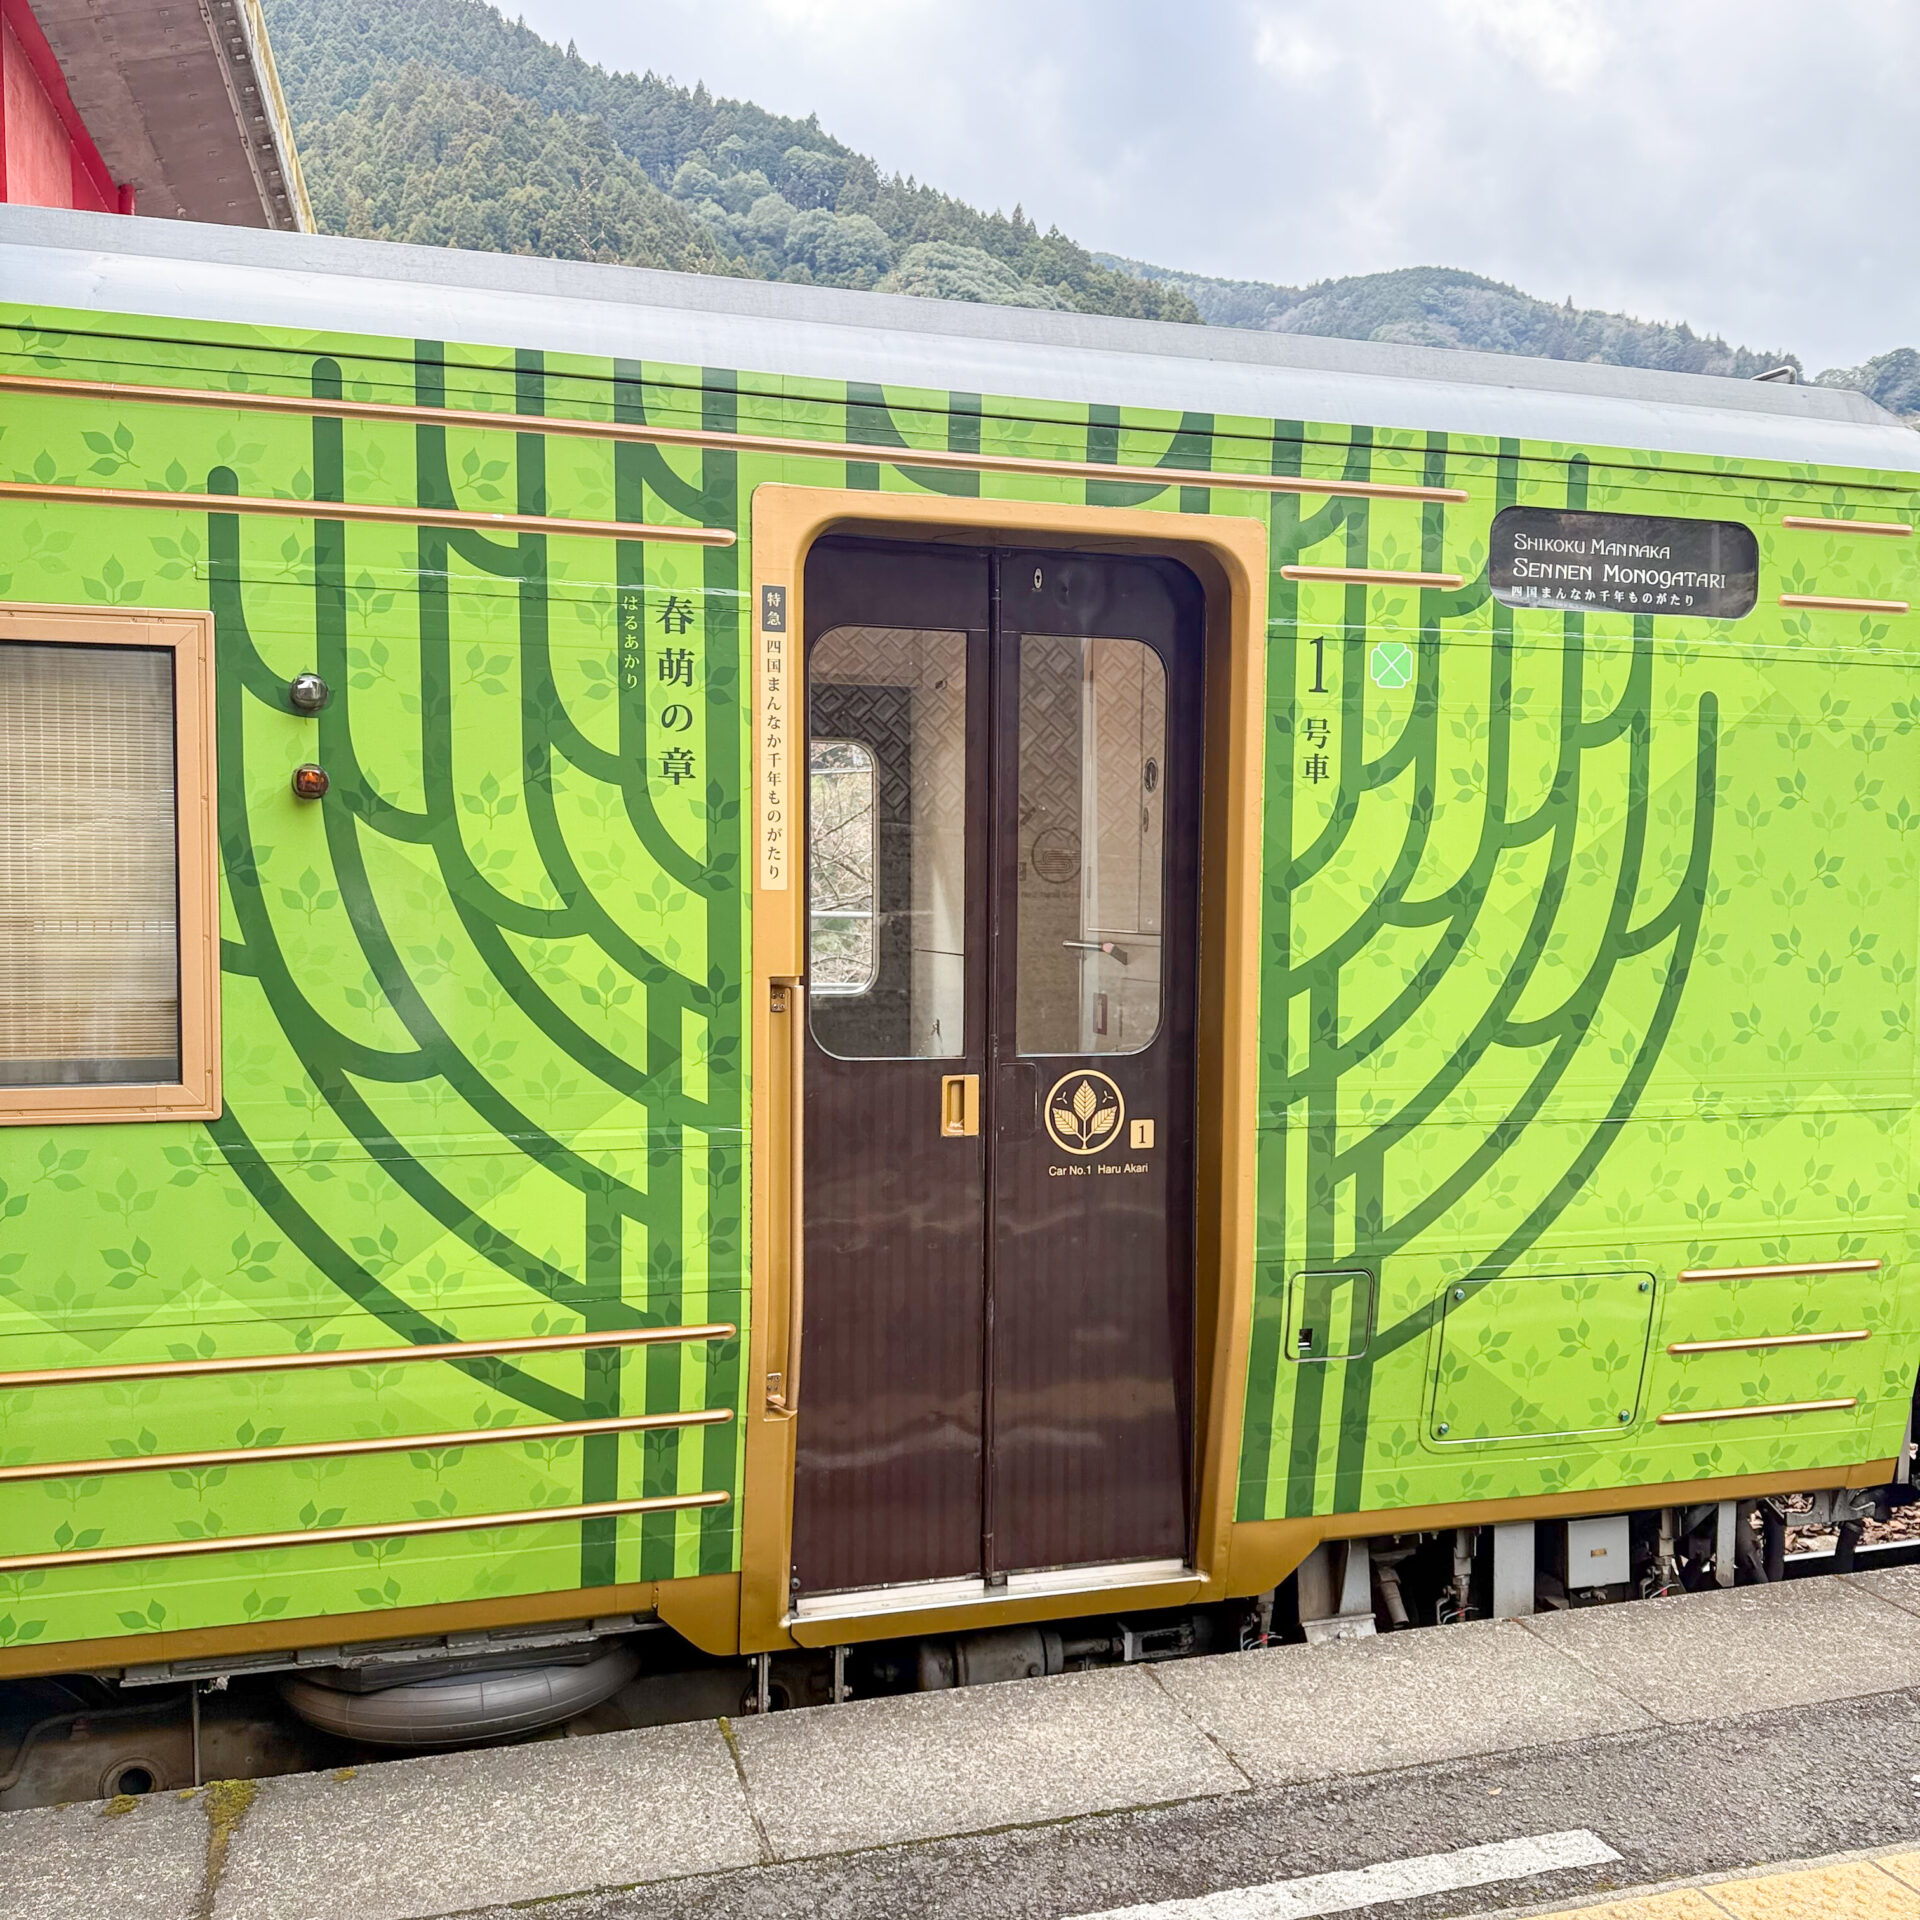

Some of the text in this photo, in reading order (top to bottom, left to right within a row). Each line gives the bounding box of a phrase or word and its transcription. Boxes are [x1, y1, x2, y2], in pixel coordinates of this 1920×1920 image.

[1514, 533, 1670, 560] SHIKOKU MANNAKA
[1512, 557, 1592, 581] SENNEN
[766, 592, 782, 626] 特急
[1511, 585, 1694, 607] 四国まんなか千年ものがたり
[621, 595, 640, 689] はるあかり
[655, 595, 696, 785] 春萌の章
[766, 639, 782, 880] 四国まんなか千年ものがたり
[1138, 1125, 1146, 1144] 1
[1048, 1163, 1149, 1176] Car No.1 Haru Akari
